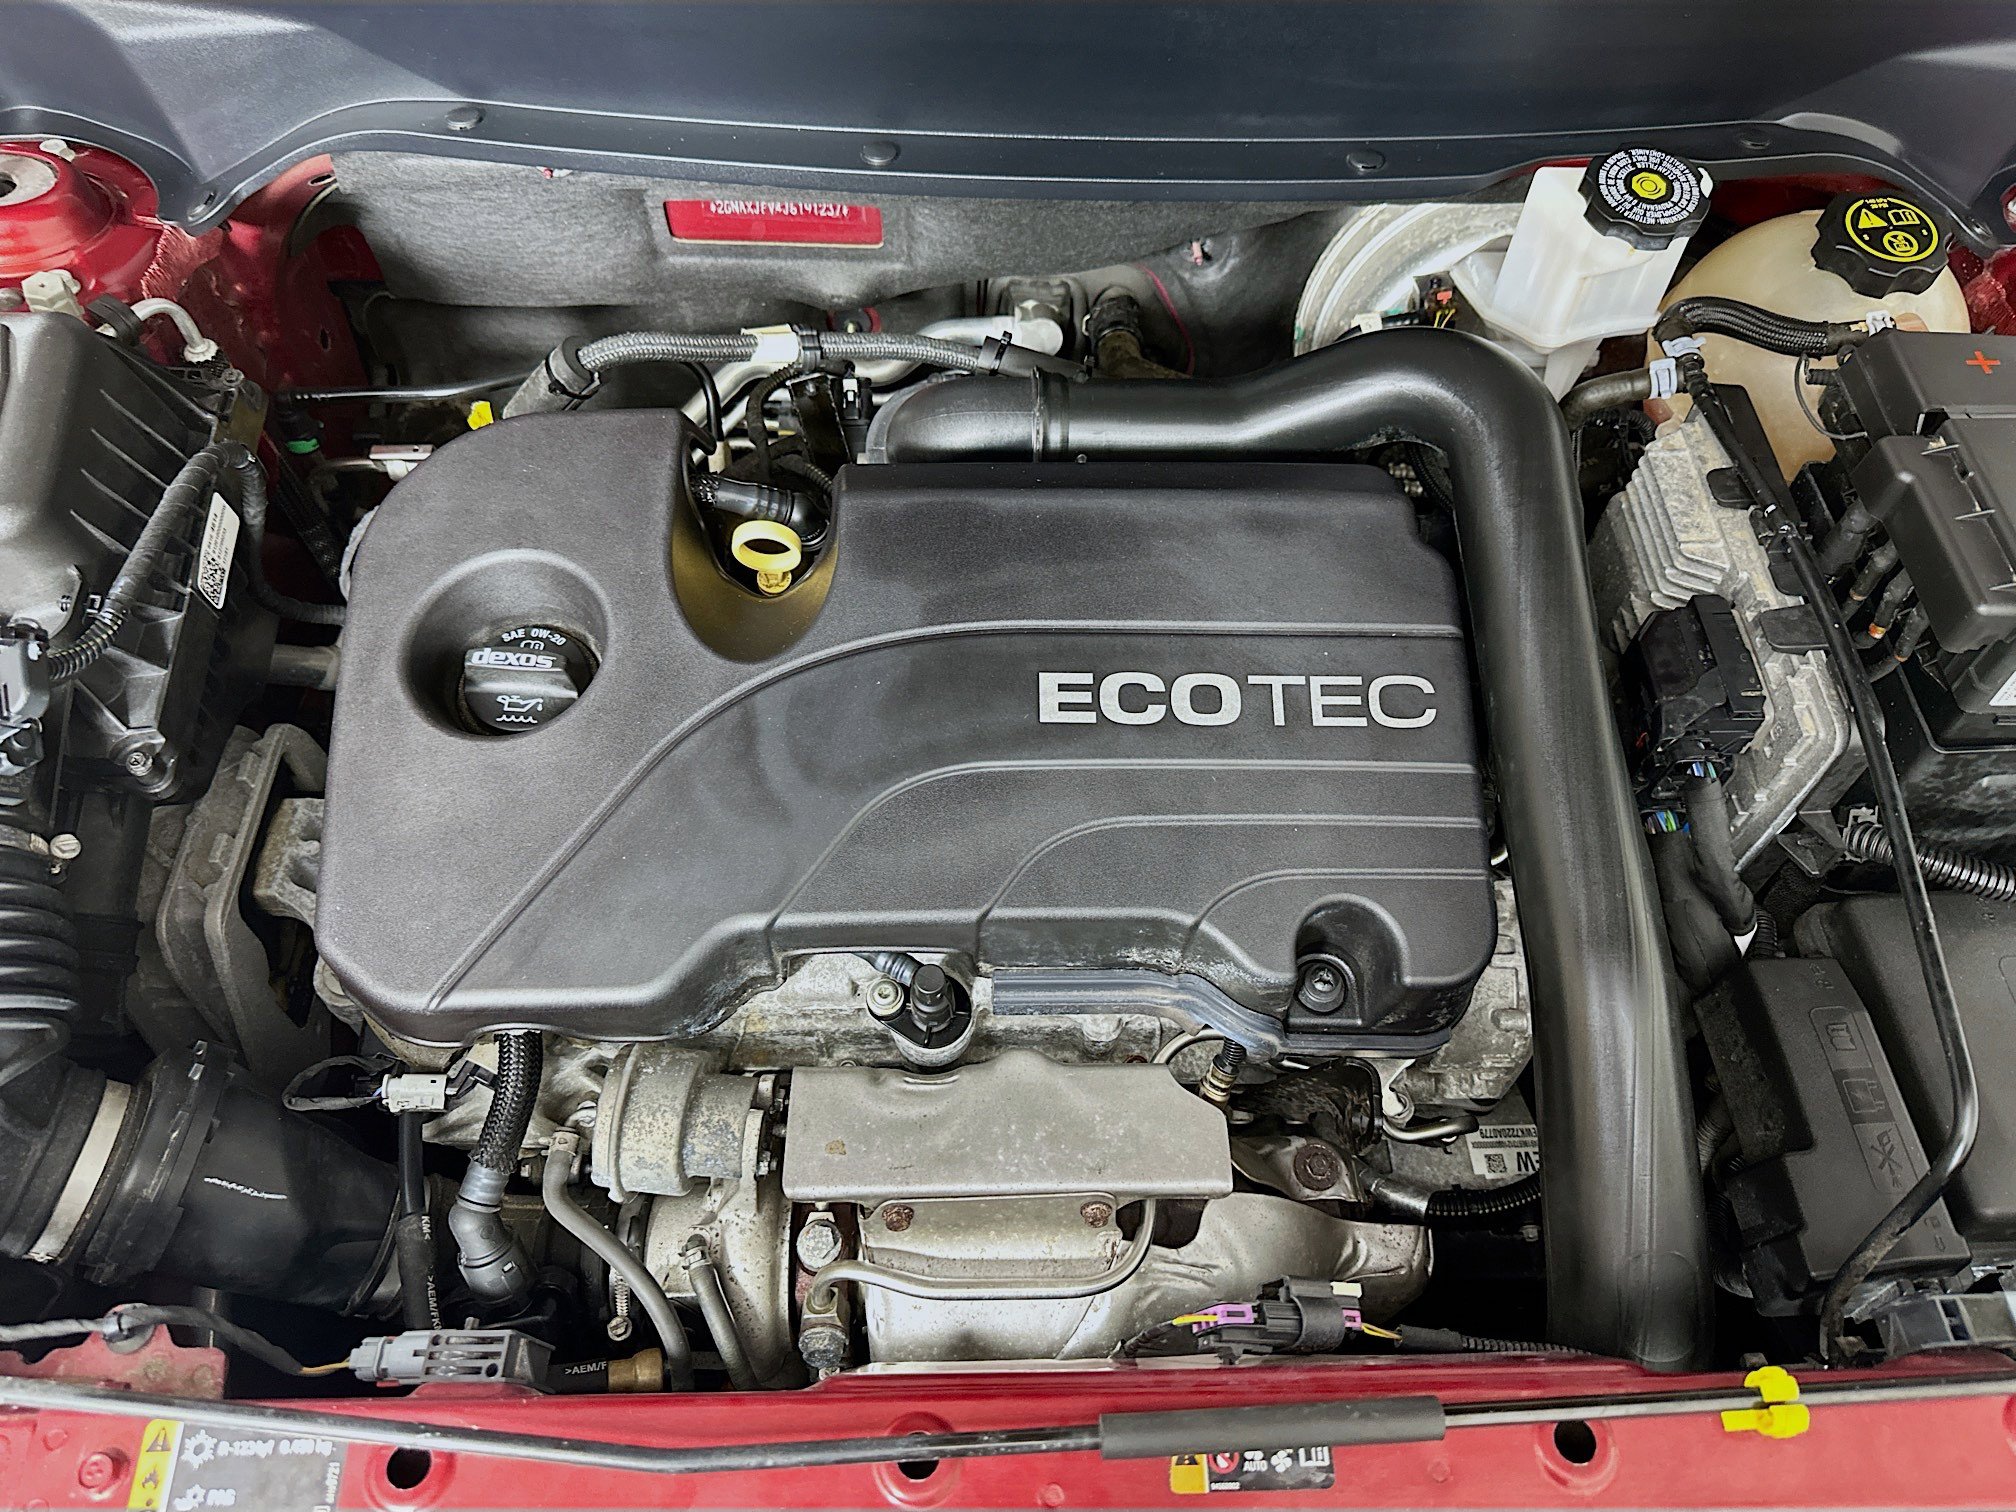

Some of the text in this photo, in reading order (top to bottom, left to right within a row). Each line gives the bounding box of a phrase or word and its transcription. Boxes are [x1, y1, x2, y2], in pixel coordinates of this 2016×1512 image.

[1649, 156, 1660, 164] USE
[1664, 155, 1688, 171] SEALED
[1657, 166, 1676, 180] CLEAN
[1615, 205, 1625, 213] LE
[1621, 201, 1632, 210] DU
[1631, 207, 1645, 216] QUE
[1623, 210, 1655, 224] NETTOYER
[502, 628, 566, 646] SAE 0W-20
[472, 648, 556, 669] dexos
[1038, 672, 1438, 728] ECOTEC
[1243, 1460, 1268, 1472] AUTO
